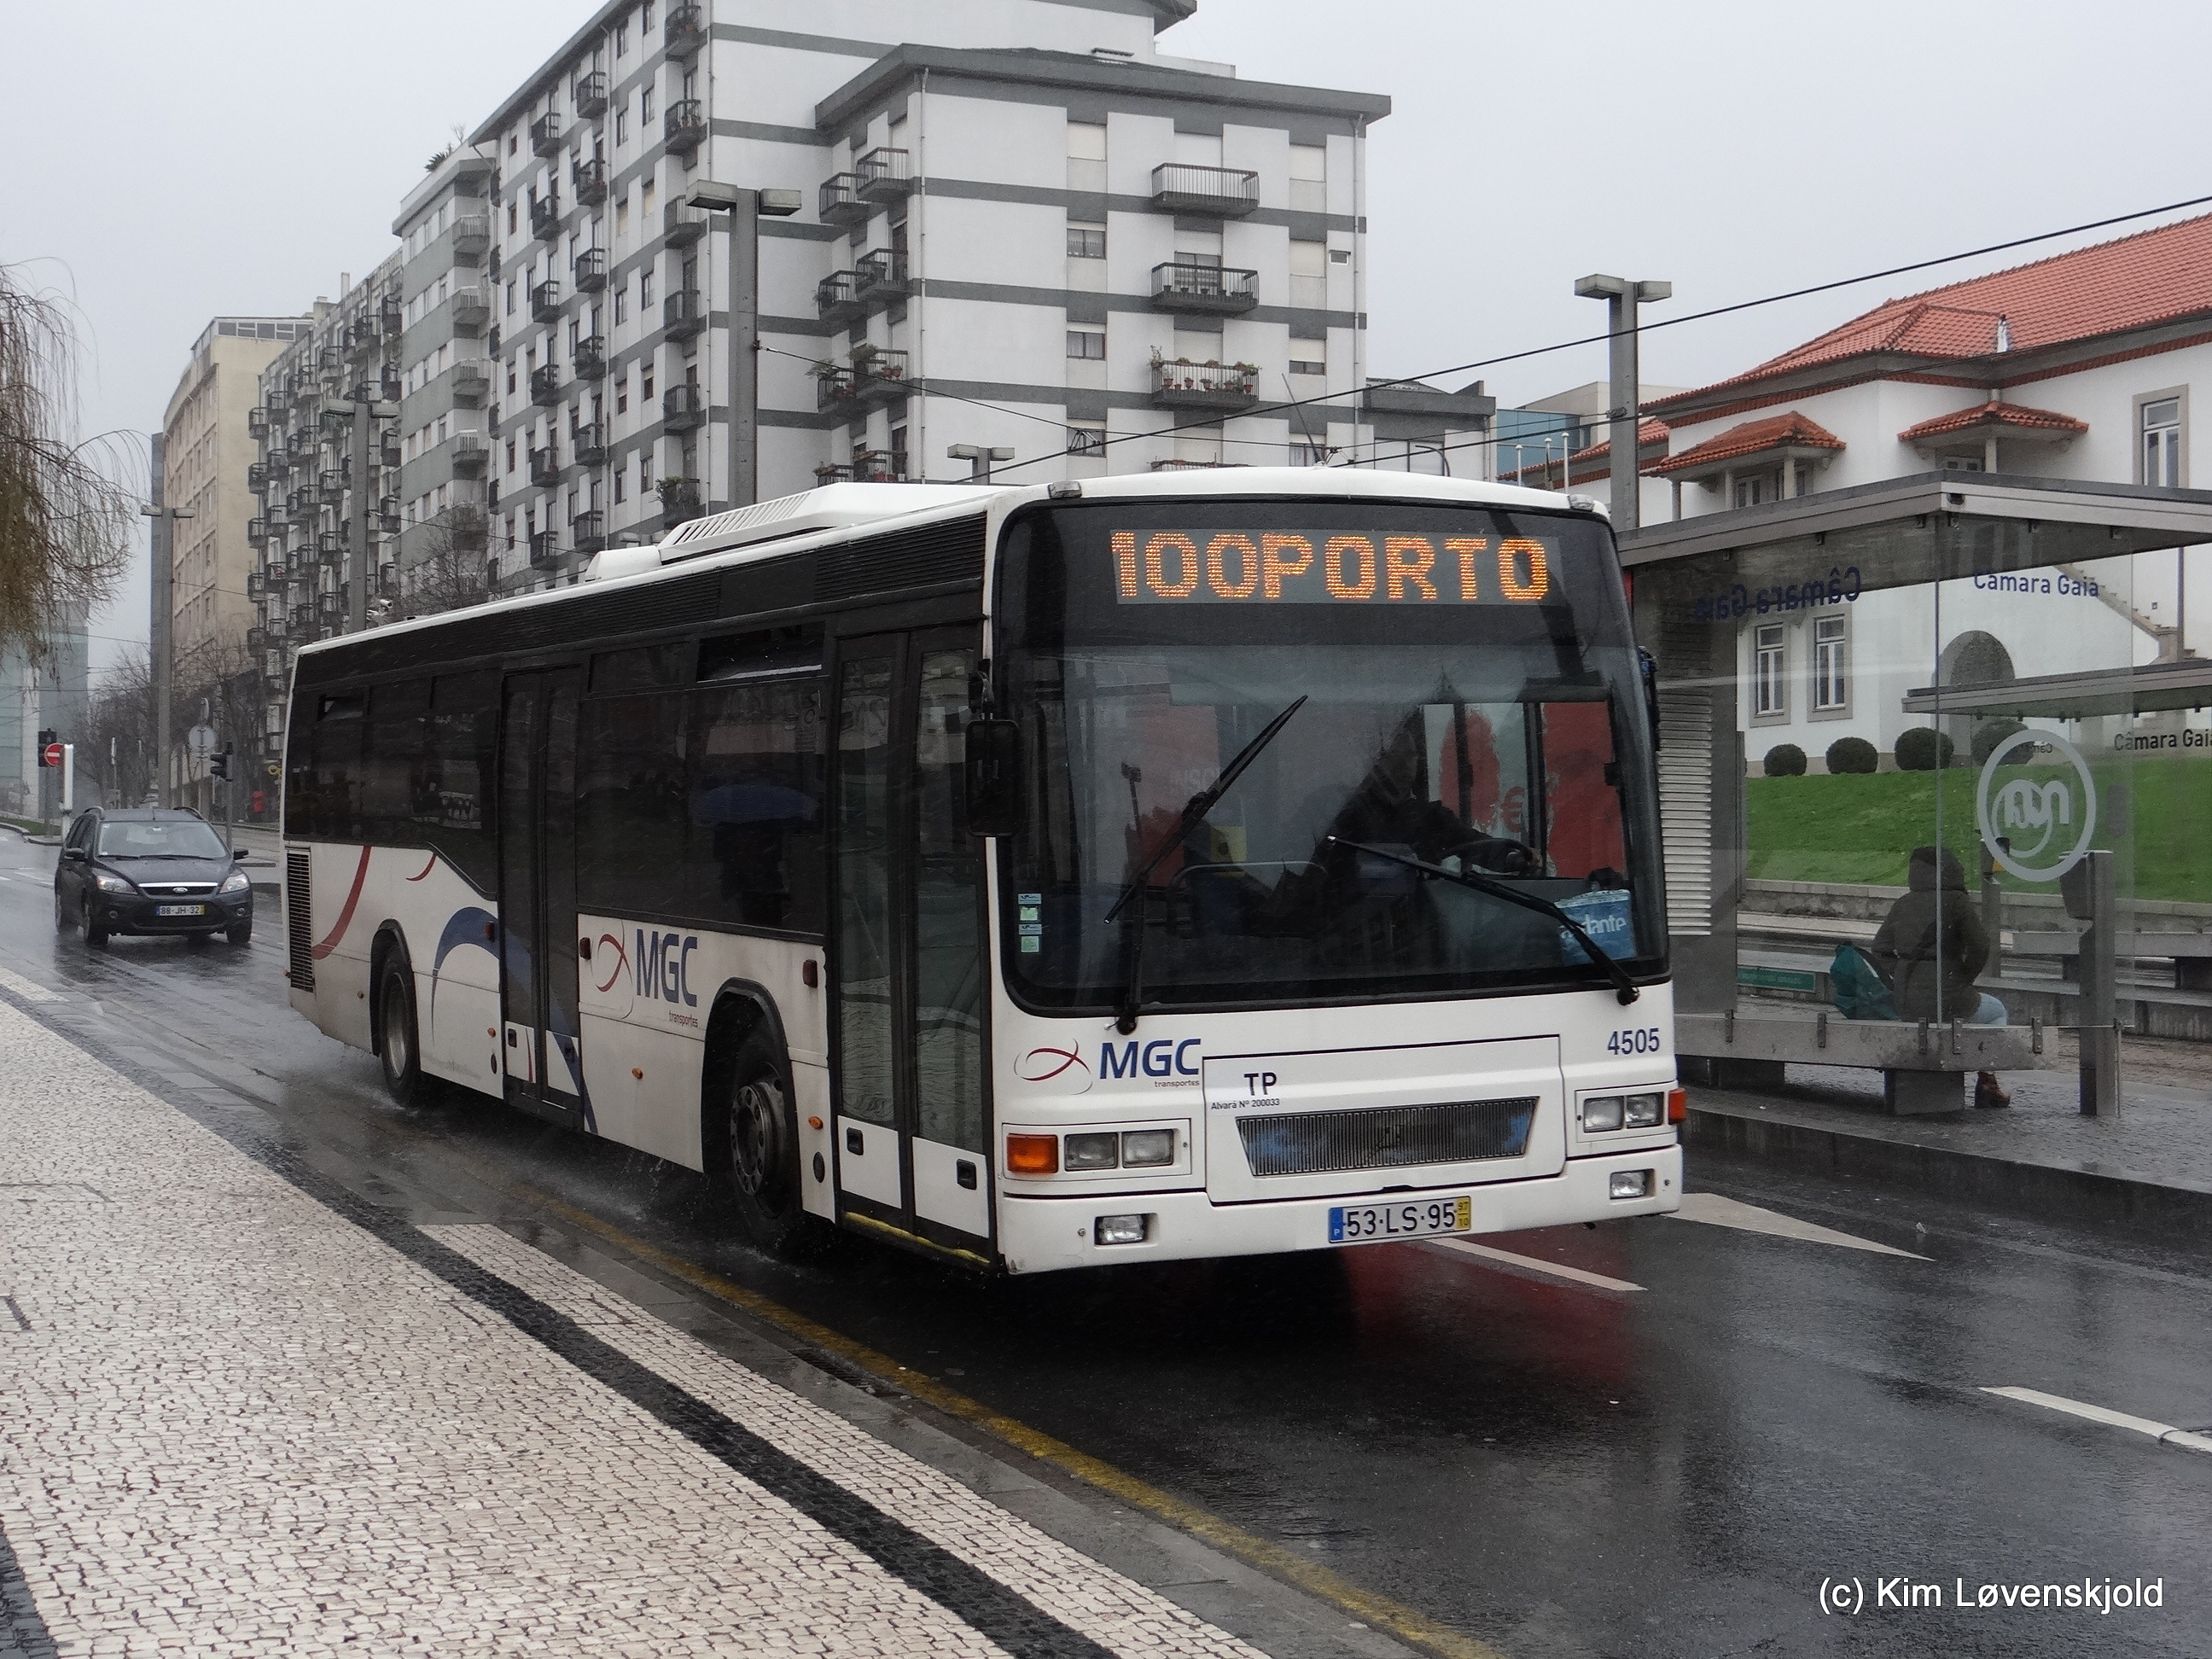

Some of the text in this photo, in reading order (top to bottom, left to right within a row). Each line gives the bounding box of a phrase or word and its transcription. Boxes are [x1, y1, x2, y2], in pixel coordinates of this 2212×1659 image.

[2058, 573, 2099, 597] Gaia
[2114, 731, 2178, 751] Câmara
[637, 928, 697, 1007] MGC
[669, 1010, 698, 1027] transportes
[1607, 1027, 1660, 1055] 4505
[1099, 1038, 1201, 1080] MGC
[1155, 1079, 1200, 1088] transportes
[1243, 1072, 1278, 1096] TP
[1211, 1099, 1237, 1110] Alvará
[1251, 1098, 1280, 1108] 200033
